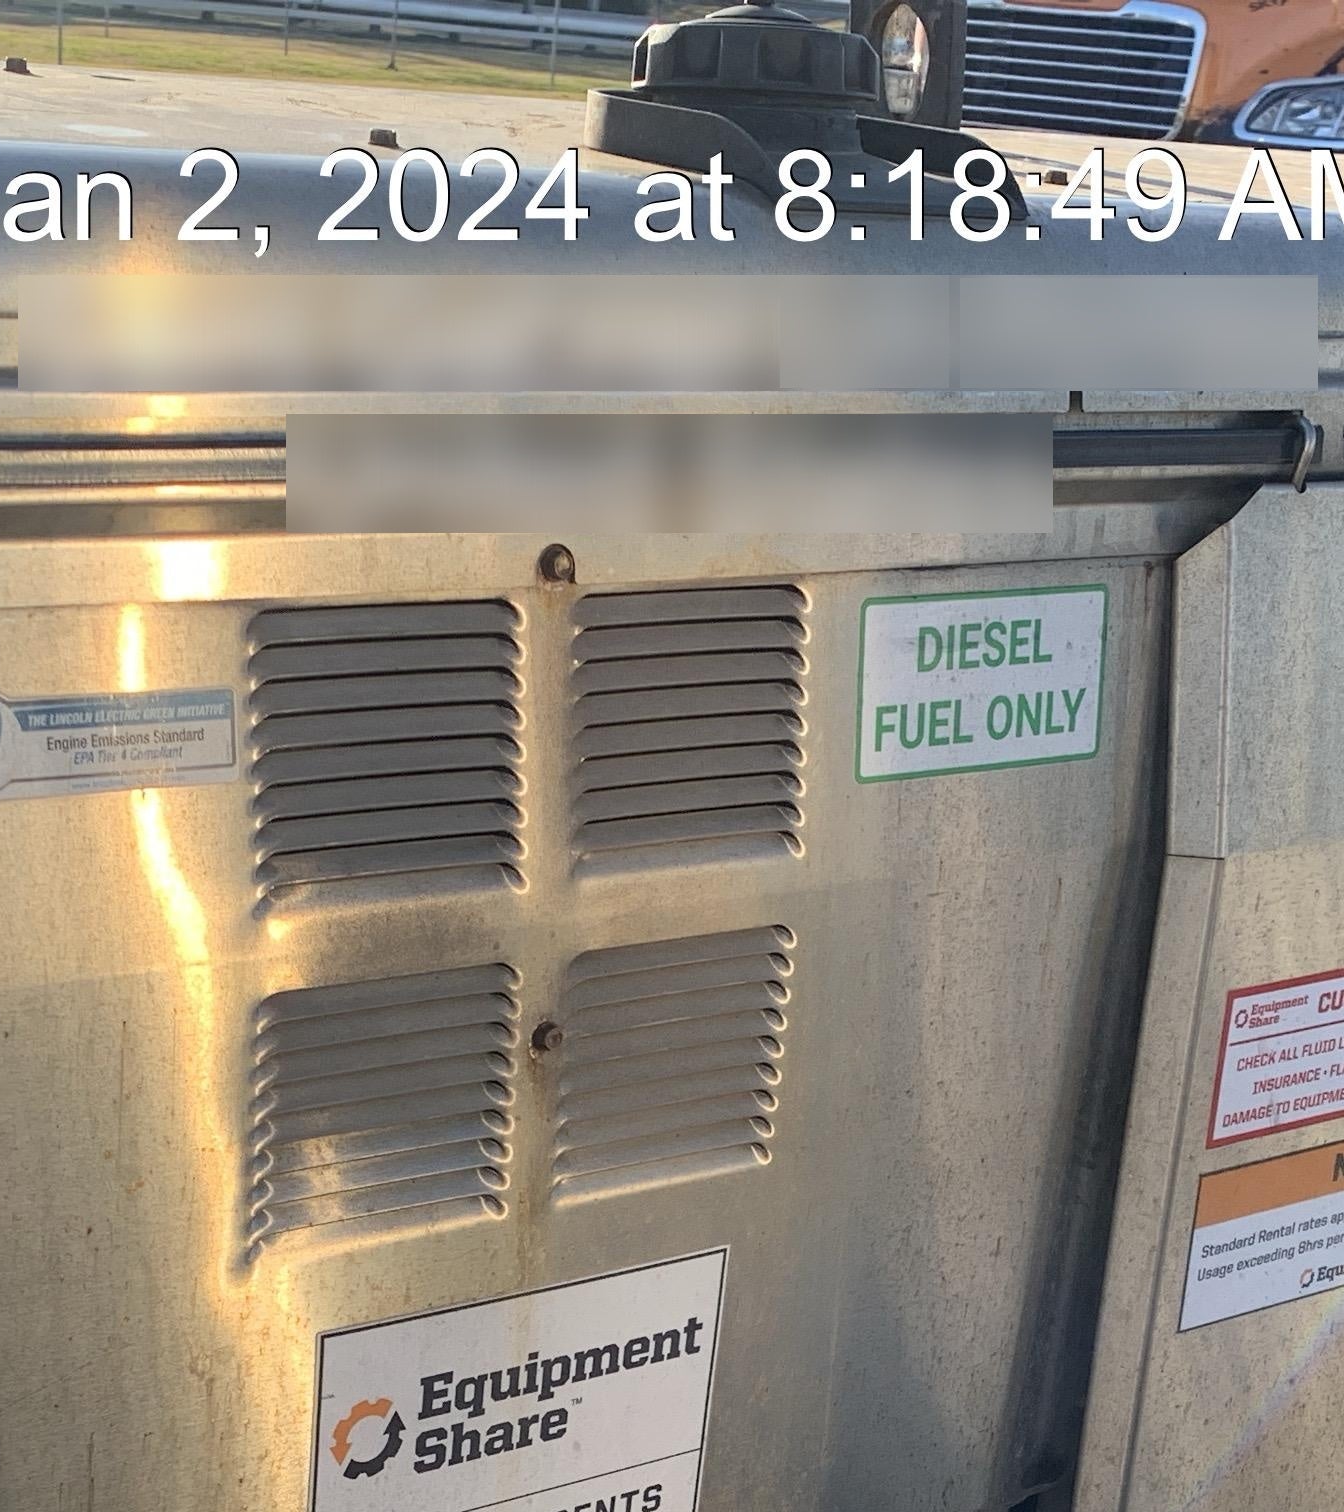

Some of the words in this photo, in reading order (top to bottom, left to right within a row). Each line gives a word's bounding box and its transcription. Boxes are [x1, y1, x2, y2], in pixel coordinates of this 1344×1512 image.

[917, 618, 1053, 673] DIESEL
[27, 713, 47, 727] THE
[50, 710, 94, 726] LINCOLN
[95, 707, 142, 724] ELECTRIC
[874, 699, 973, 753] FUEL
[986, 687, 1087, 742] ONLY
[47, 736, 88, 752] Engine
[91, 731, 150, 747] Emissions
[153, 727, 205, 743] Standard
[74, 753, 95, 765] EPA
[1251, 993, 1310, 1016] Equipment
[1248, 1013, 1280, 1029] Share
[1237, 1051, 1276, 1071] CHECK
[1278, 1046, 1299, 1063] ALL
[1301, 1037, 1336, 1059] FLUID
[1252, 1068, 1321, 1095] INSURANCE
[1222, 1105, 1274, 1128] DAMAGE
[1275, 1100, 1291, 1116] TO
[1201, 1232, 1256, 1260] Standard
[1258, 1222, 1296, 1244] Rental
[1298, 1215, 1328, 1235] rates
[1197, 1262, 1234, 1285] Usage
[1236, 1246, 1295, 1278] exceeding
[1298, 1238, 1324, 1255] 8hrs
[417, 1316, 704, 1421] Equipment
[412, 1406, 569, 1475] Share
